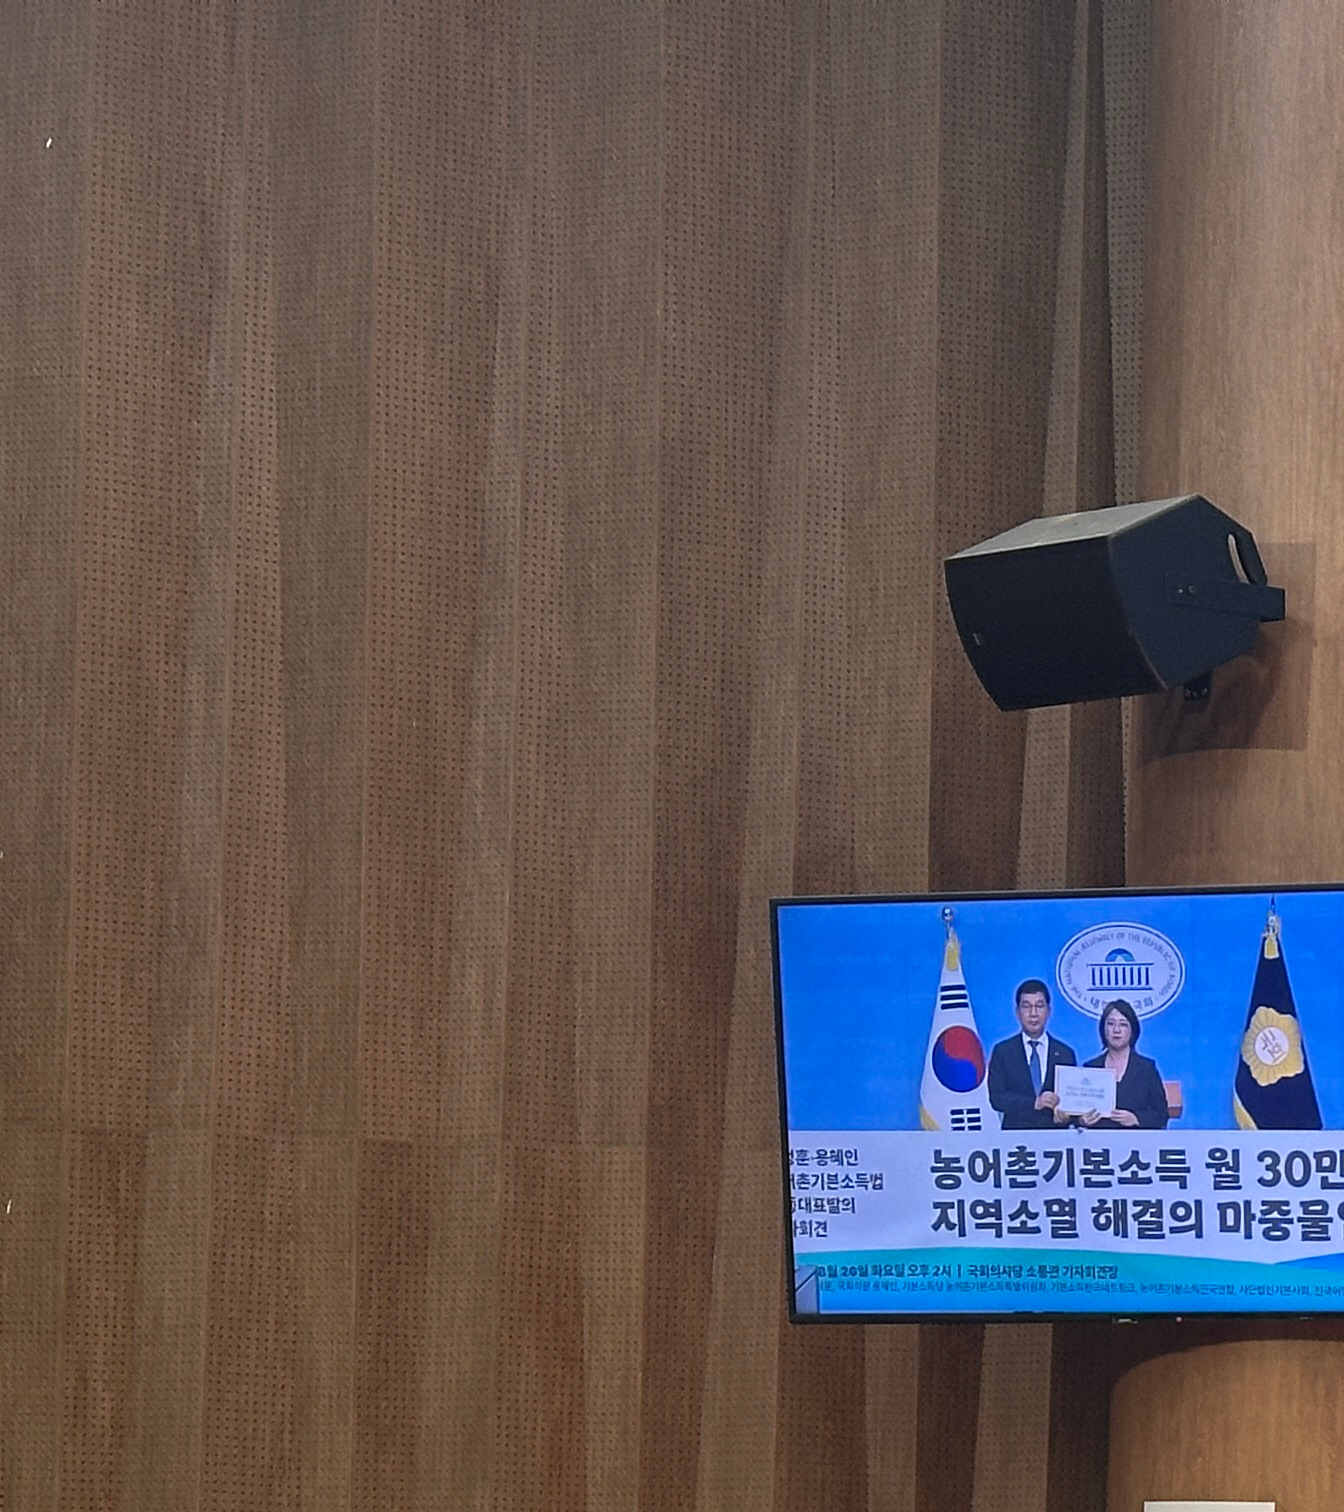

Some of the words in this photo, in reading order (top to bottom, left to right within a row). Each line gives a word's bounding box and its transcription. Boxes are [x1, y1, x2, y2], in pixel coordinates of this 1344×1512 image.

[930, 1146, 1191, 1190] 농어촌기본소득
[1205, 1148, 1243, 1191] 월
[931, 1198, 1079, 1239] 지역소멸
[1091, 1198, 1203, 1240] 해결의
